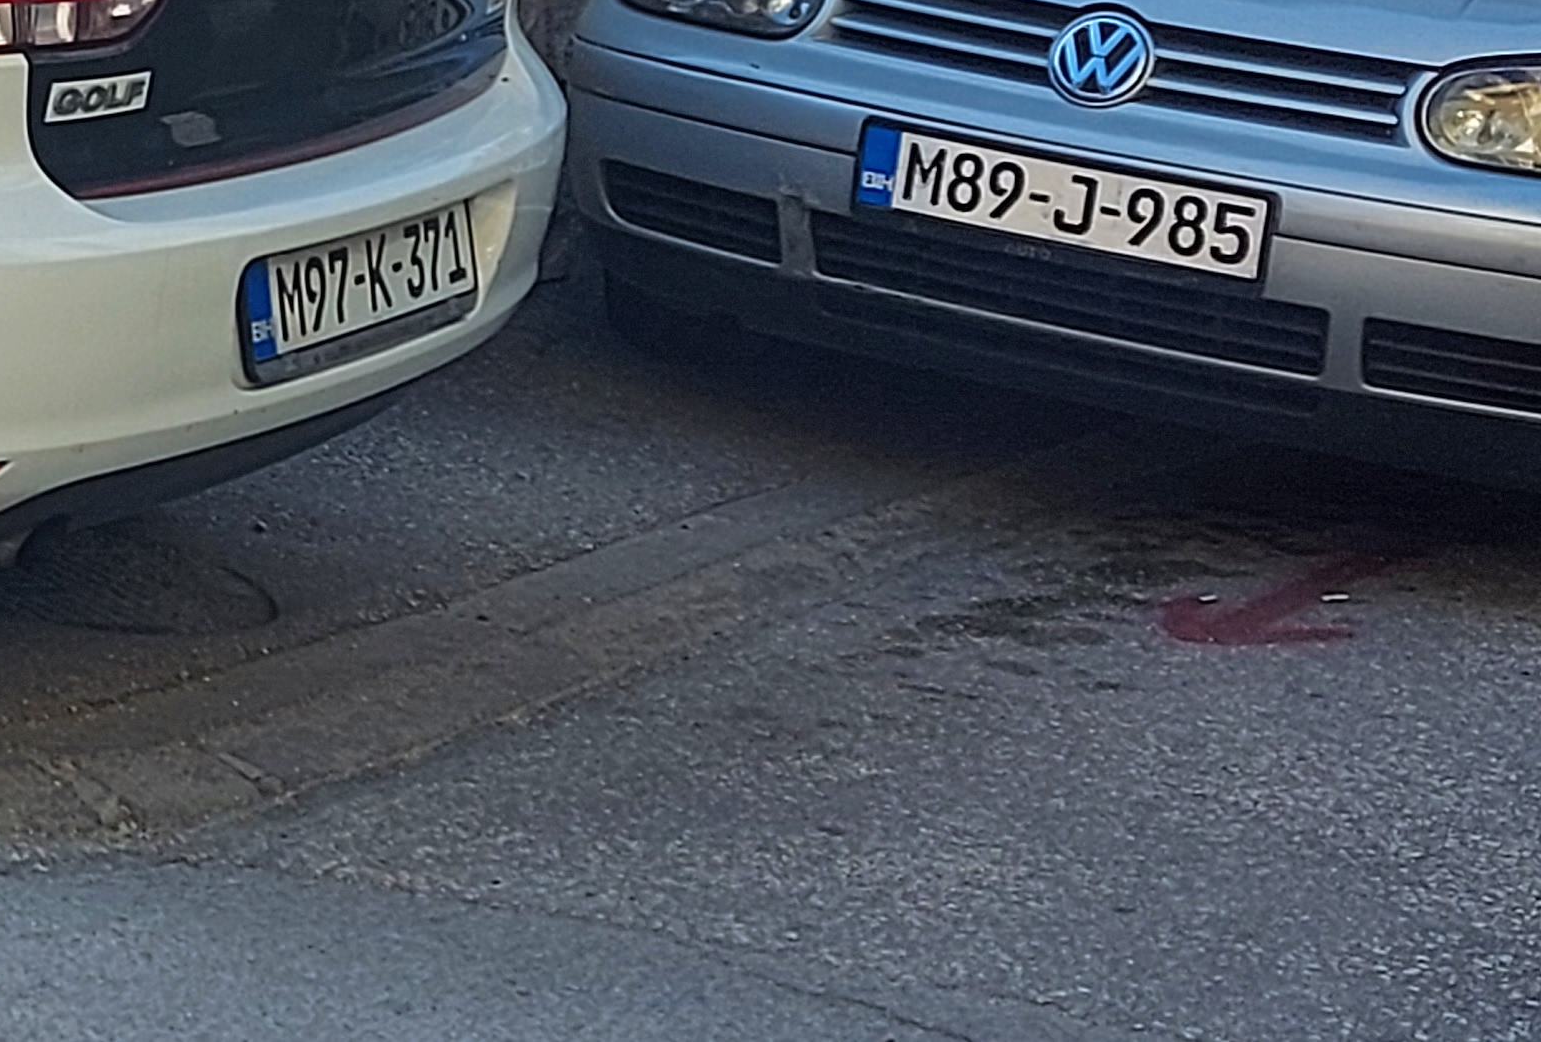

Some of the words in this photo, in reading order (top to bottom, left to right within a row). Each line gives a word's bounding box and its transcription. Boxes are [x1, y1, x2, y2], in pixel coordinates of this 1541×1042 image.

[53, 80, 146, 115] GOLF
[901, 142, 1255, 265] M89-J-985
[276, 211, 467, 342] M97-K-371
